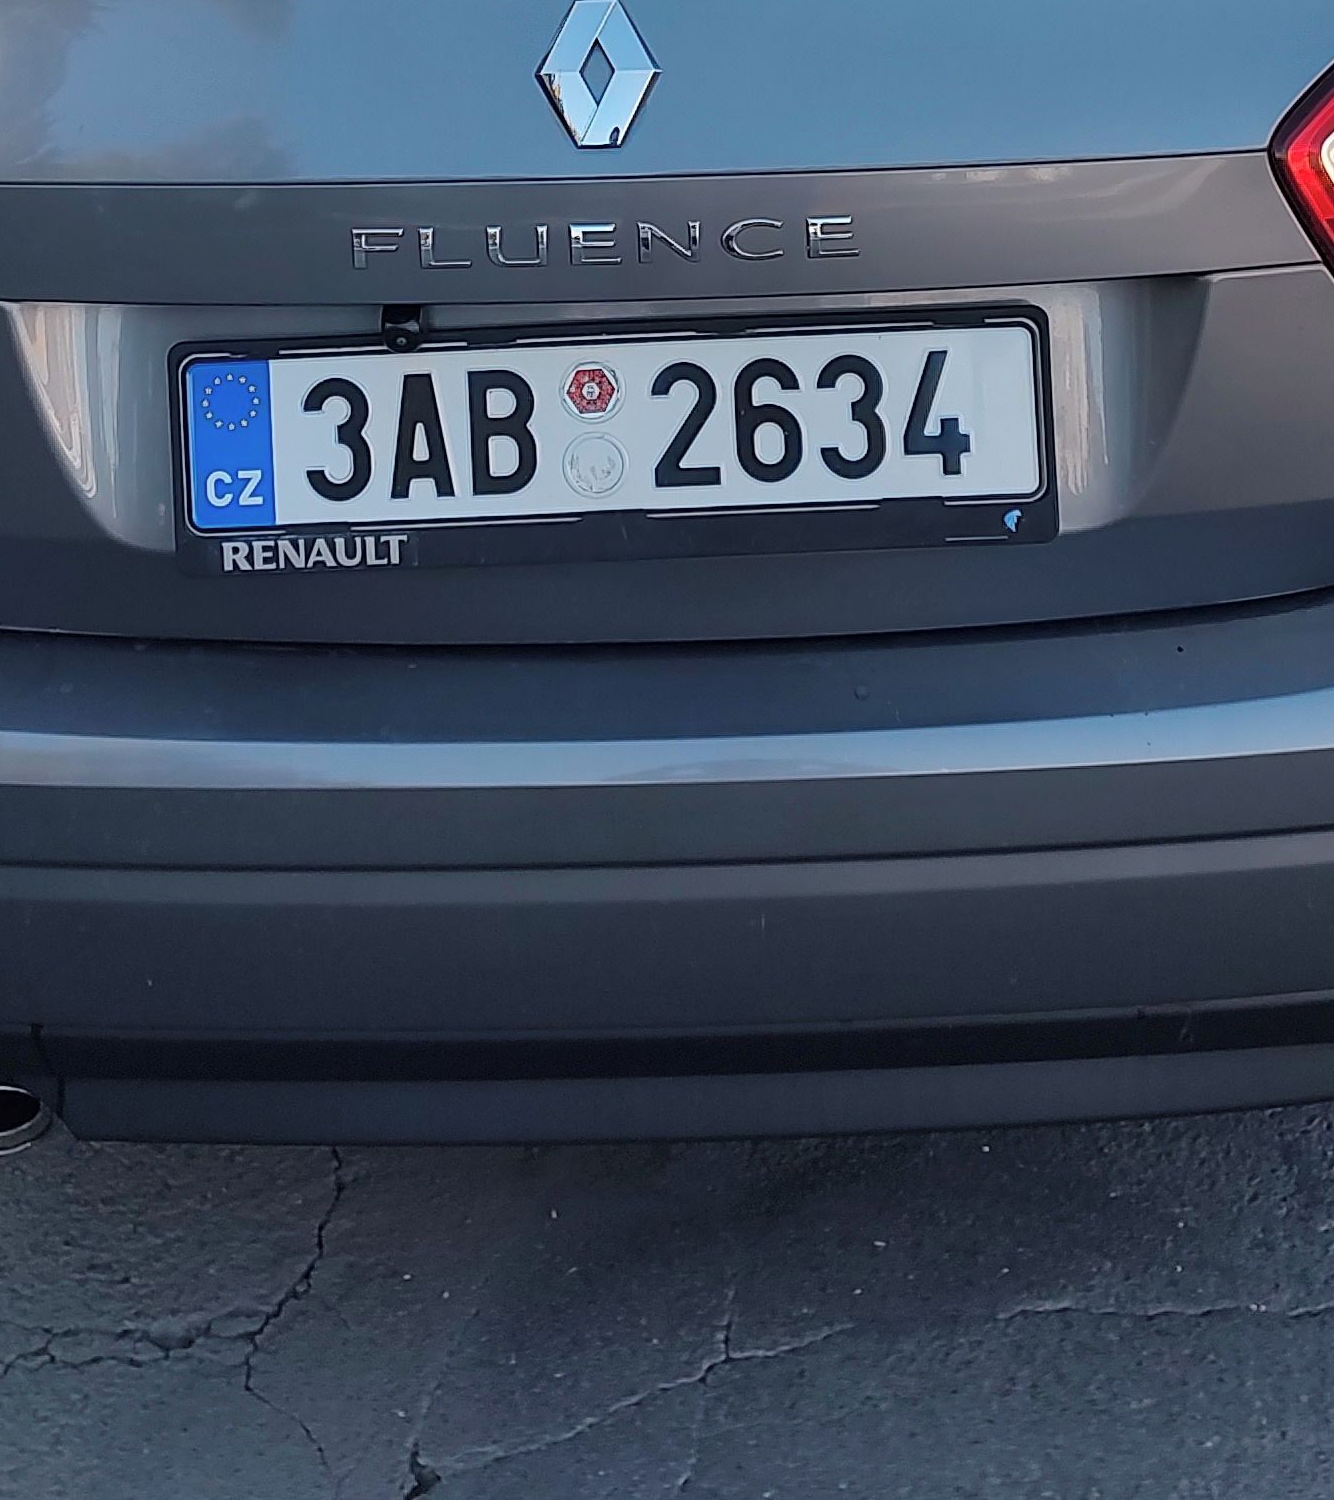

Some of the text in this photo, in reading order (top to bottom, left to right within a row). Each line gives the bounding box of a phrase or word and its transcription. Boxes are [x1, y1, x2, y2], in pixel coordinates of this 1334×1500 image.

[350, 214, 861, 270] FLUENCE
[302, 348, 971, 502] 3AB 2634
[206, 469, 264, 507] CZ
[221, 534, 408, 572] RENAULT
